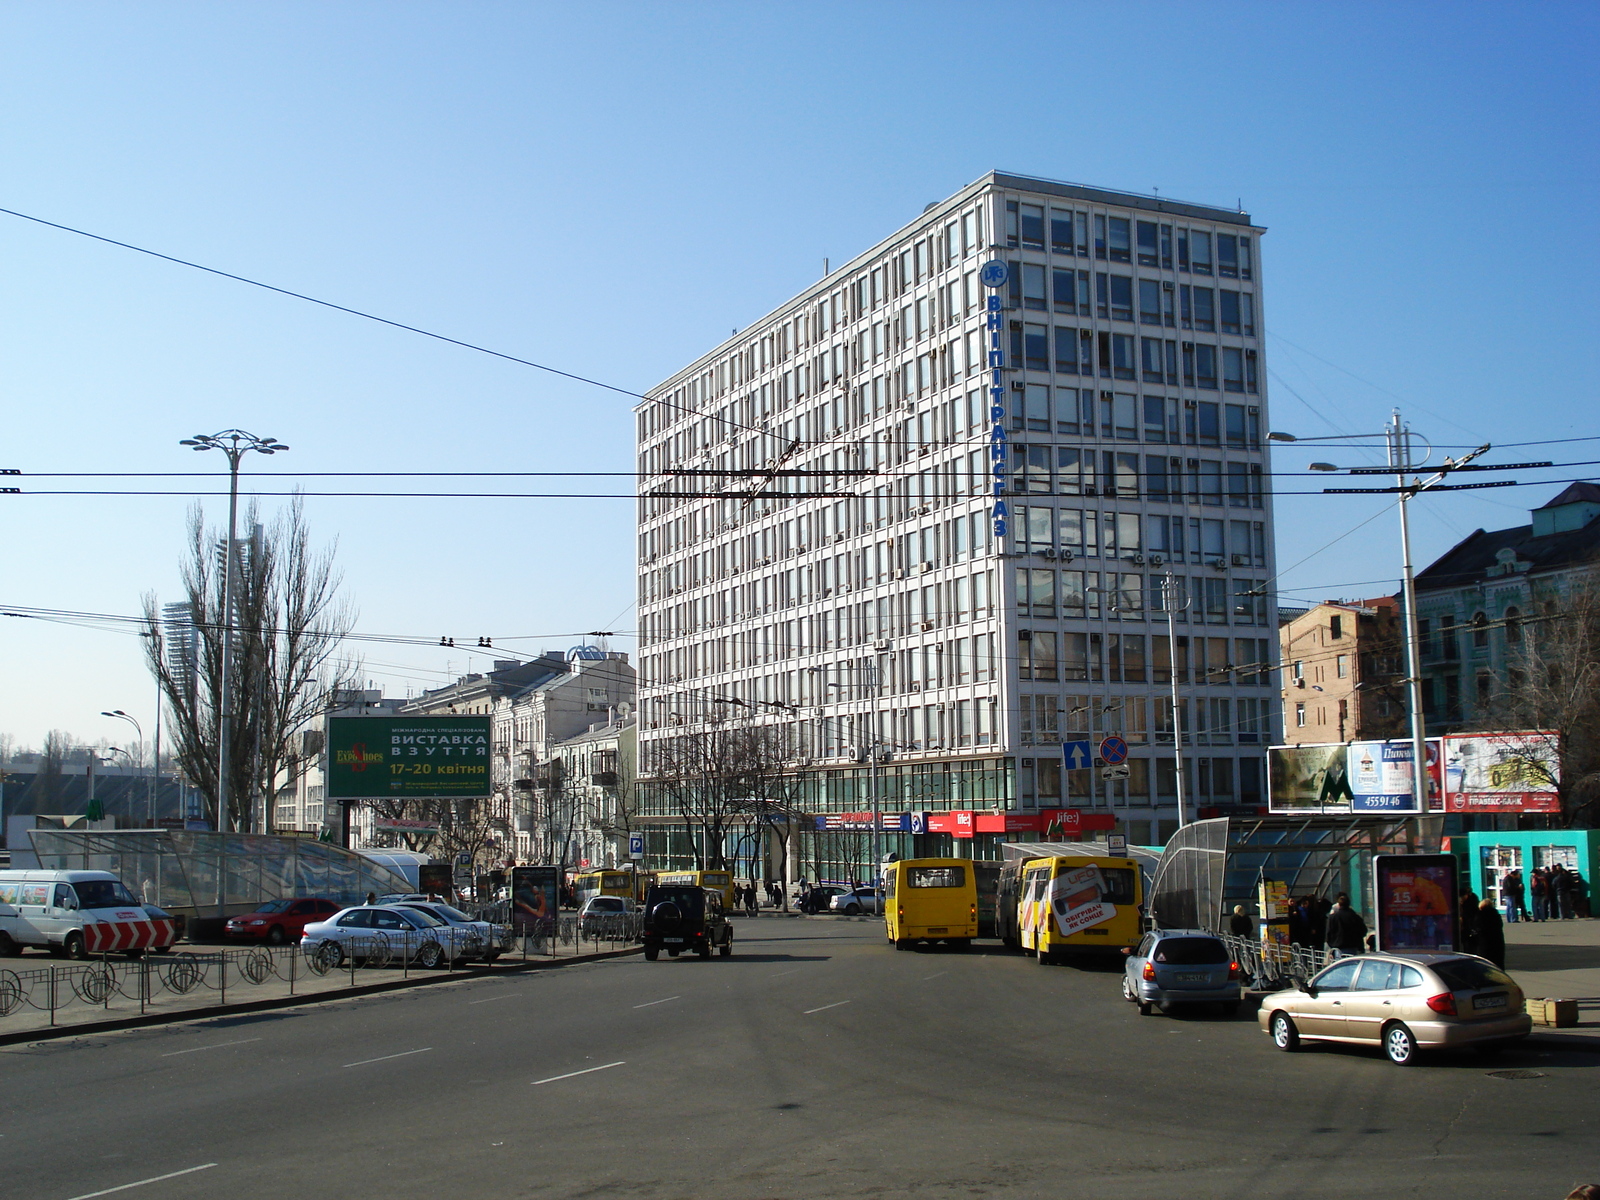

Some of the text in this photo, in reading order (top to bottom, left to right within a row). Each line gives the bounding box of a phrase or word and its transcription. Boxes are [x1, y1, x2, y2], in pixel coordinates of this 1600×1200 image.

[987, 295, 1009, 537] ВНІПІТРАНСГАЗ
[391, 735, 487, 744] ВИСТАВКА
[391, 746, 486, 756] ВЗУТТЯ
[390, 763, 485, 774] 17-20 квітня
[1365, 795, 1400, 807] 455 91 46
[956, 813, 972, 828] life:)
[1056, 811, 1080, 825] life:)
[1068, 869, 1096, 884] UFO
[1393, 891, 1411, 903] 15
[1065, 904, 1103, 923] ОБІГРІВАЧ
[1068, 910, 1105, 930] ЯК СОНЦЕ
